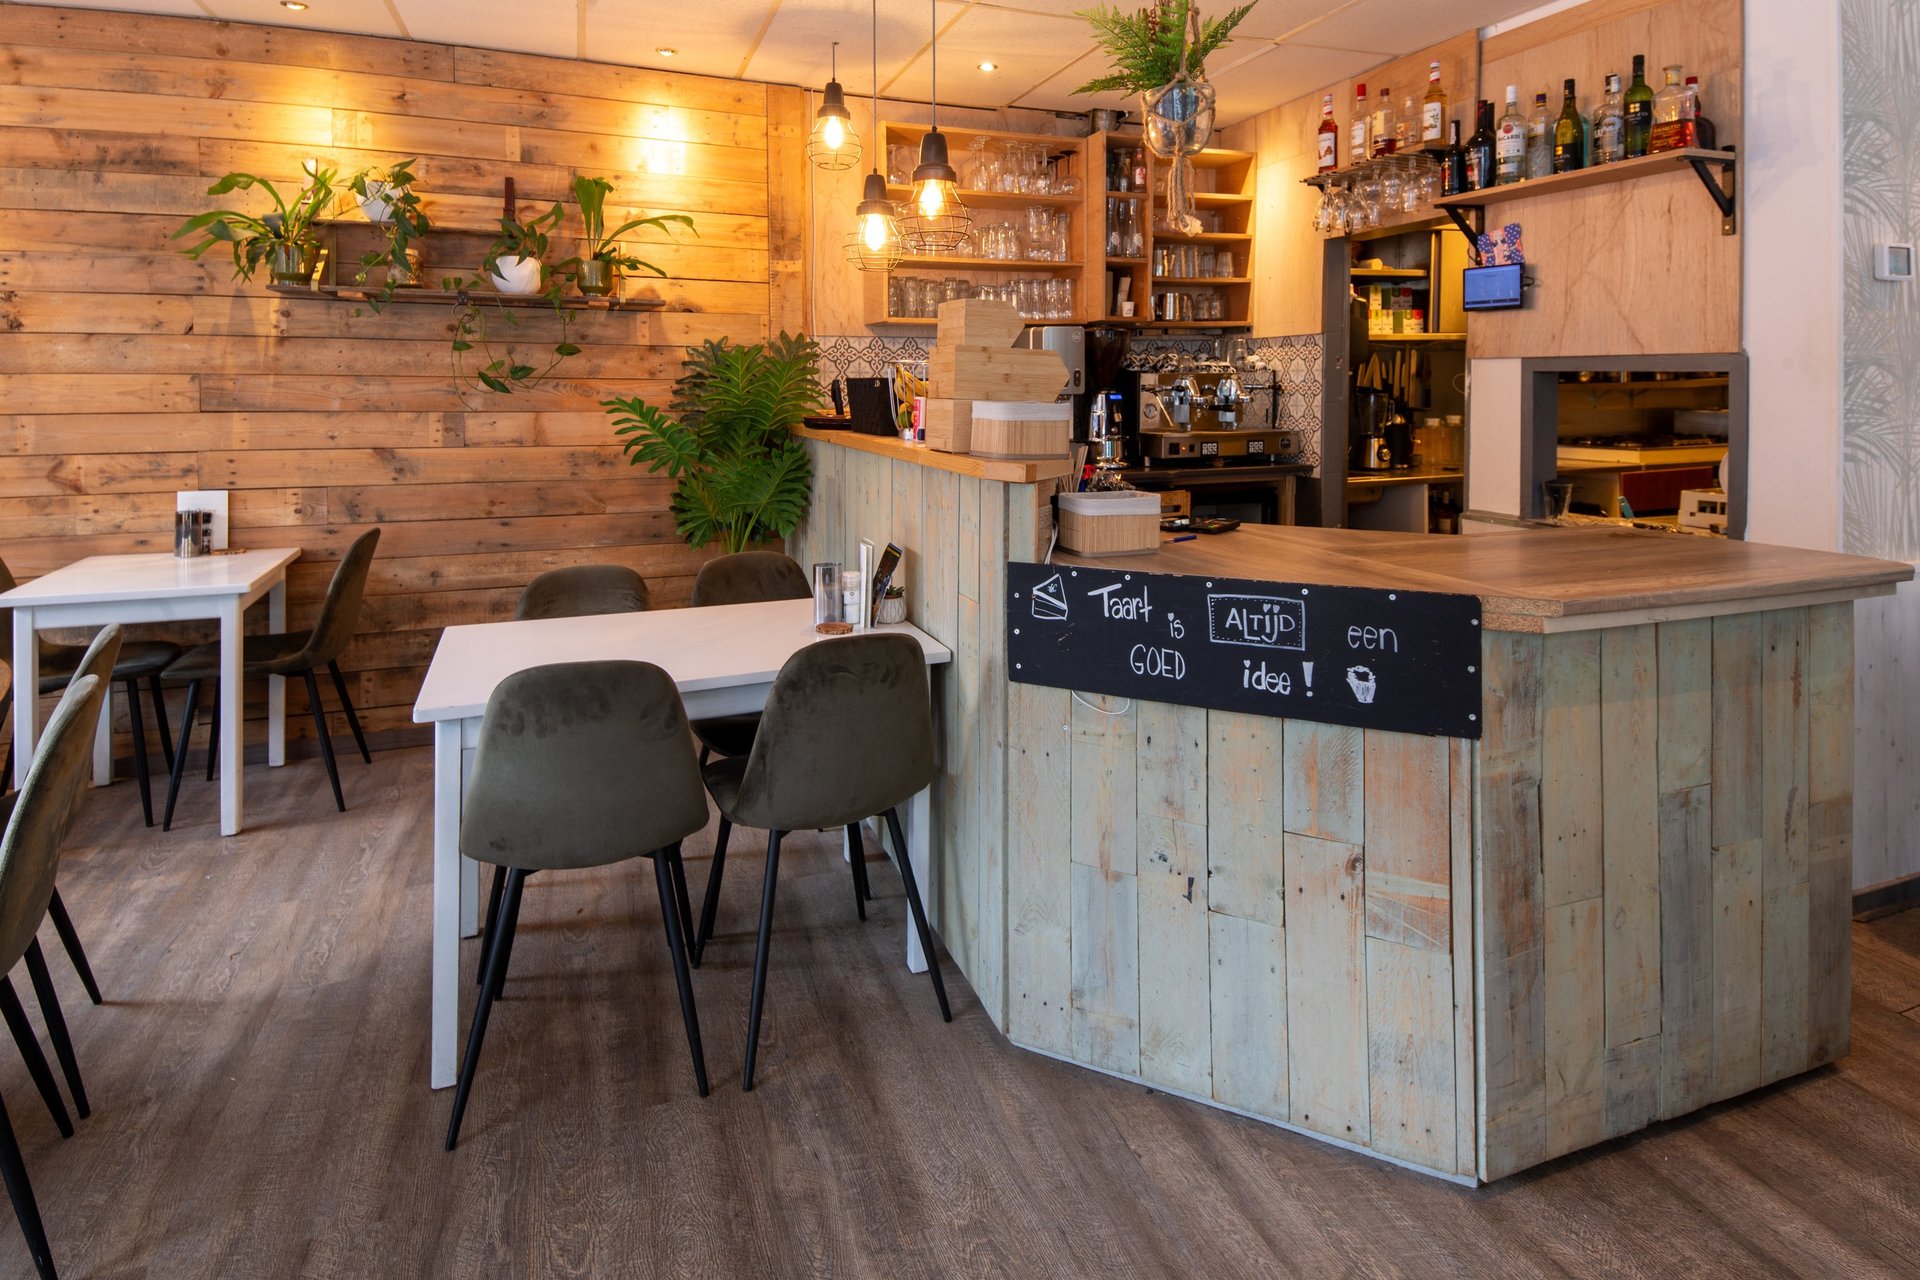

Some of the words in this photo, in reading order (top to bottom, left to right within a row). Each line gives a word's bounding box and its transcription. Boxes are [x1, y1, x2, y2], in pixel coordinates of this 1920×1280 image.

[1088, 583, 1153, 623] Taart
[1167, 612, 1185, 640] is
[1347, 625, 1398, 653] een
[1130, 643, 1186, 681] GOED
